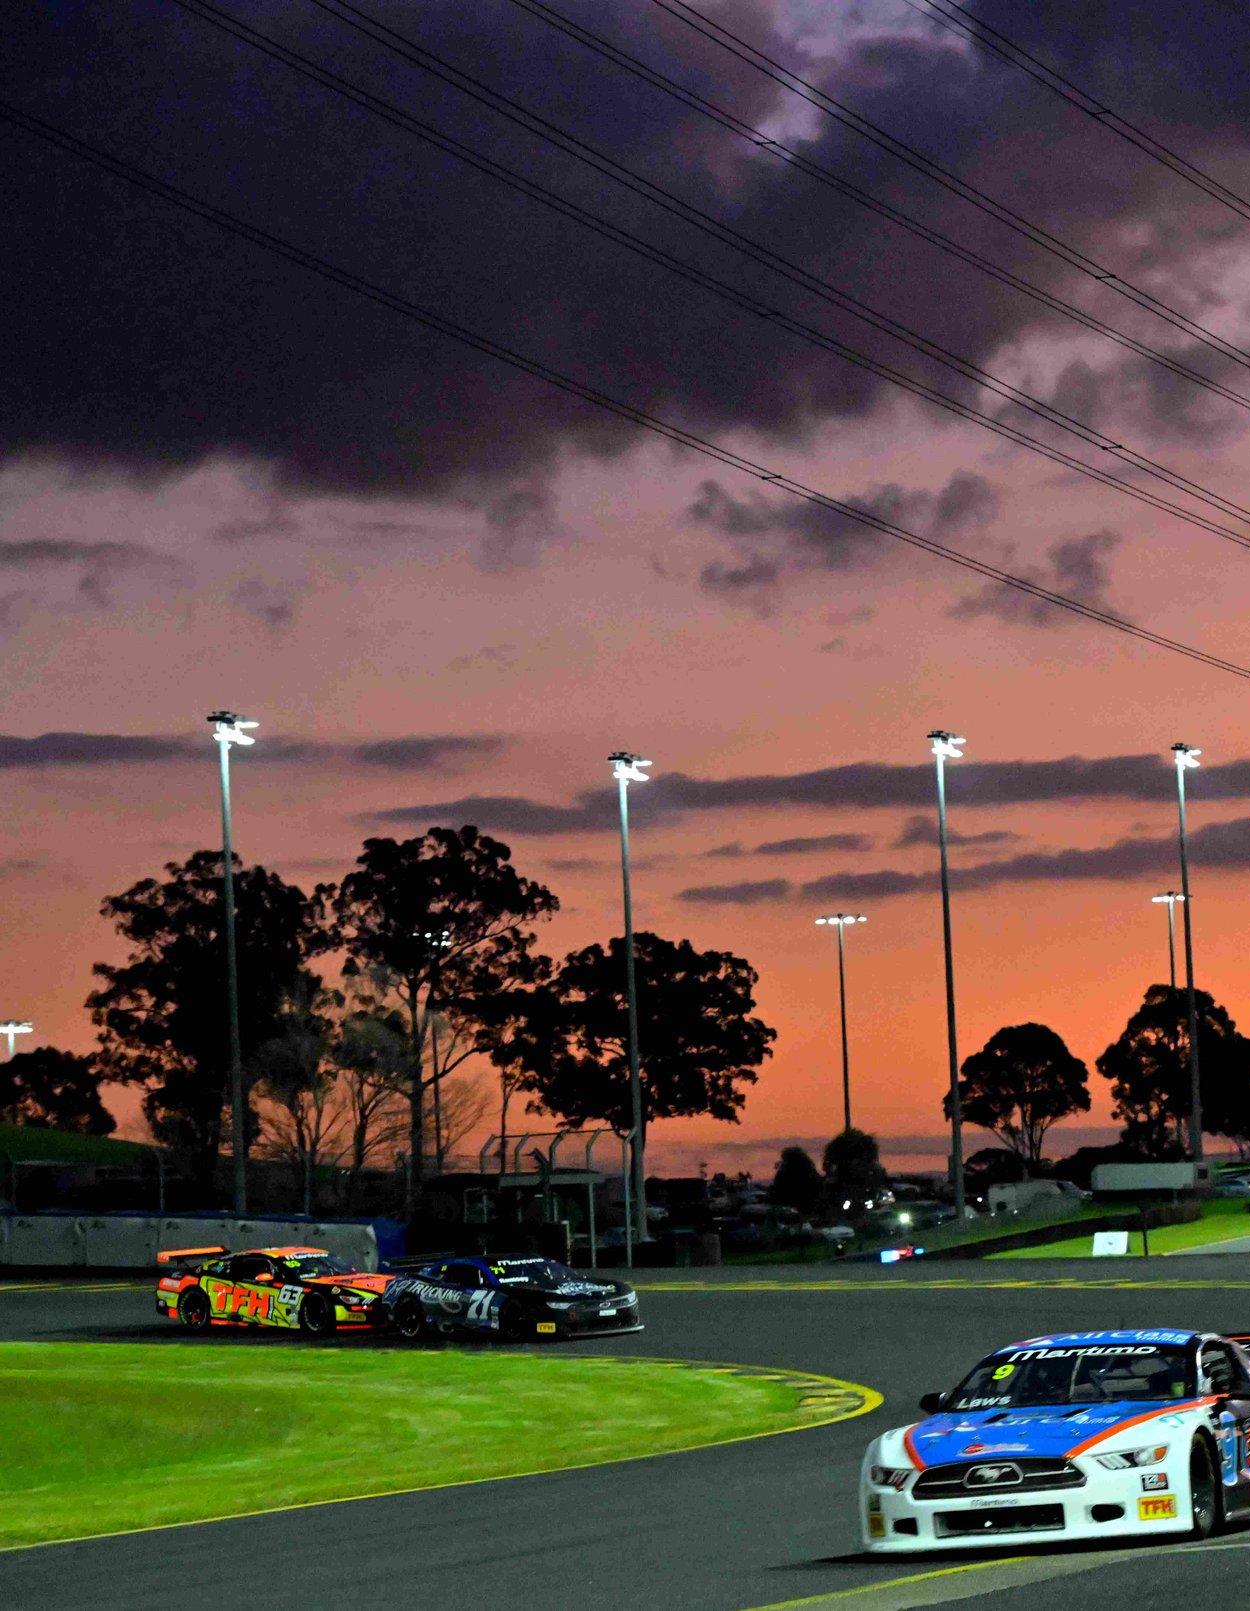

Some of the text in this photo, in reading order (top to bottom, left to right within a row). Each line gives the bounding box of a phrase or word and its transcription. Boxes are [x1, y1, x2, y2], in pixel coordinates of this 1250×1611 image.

[212, 1283, 270, 1319] TFH
[278, 1284, 304, 1306] 63
[408, 1281, 463, 1301] TRUCKING
[467, 1289, 496, 1320] 71
[1007, 1345, 1157, 1363] Maritimo
[991, 1364, 1016, 1381] 9
